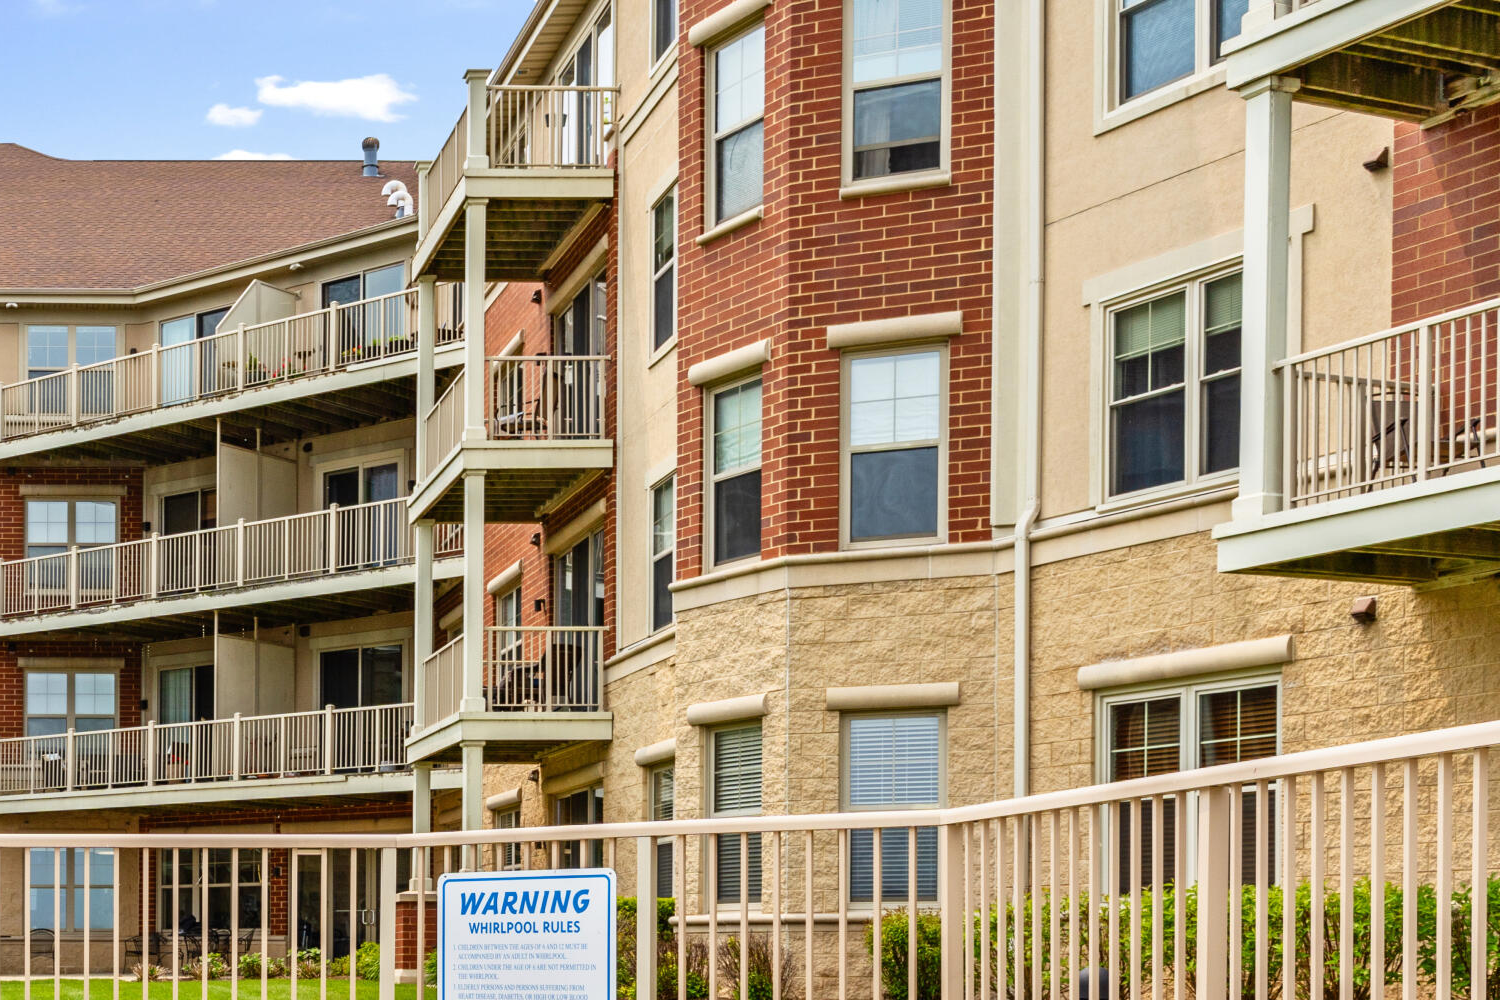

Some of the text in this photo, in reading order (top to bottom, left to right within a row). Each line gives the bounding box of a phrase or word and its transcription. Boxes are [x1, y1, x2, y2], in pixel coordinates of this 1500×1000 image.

[461, 889, 590, 915] WARNING
[469, 920, 580, 934] WHIRLPOOL RULES
